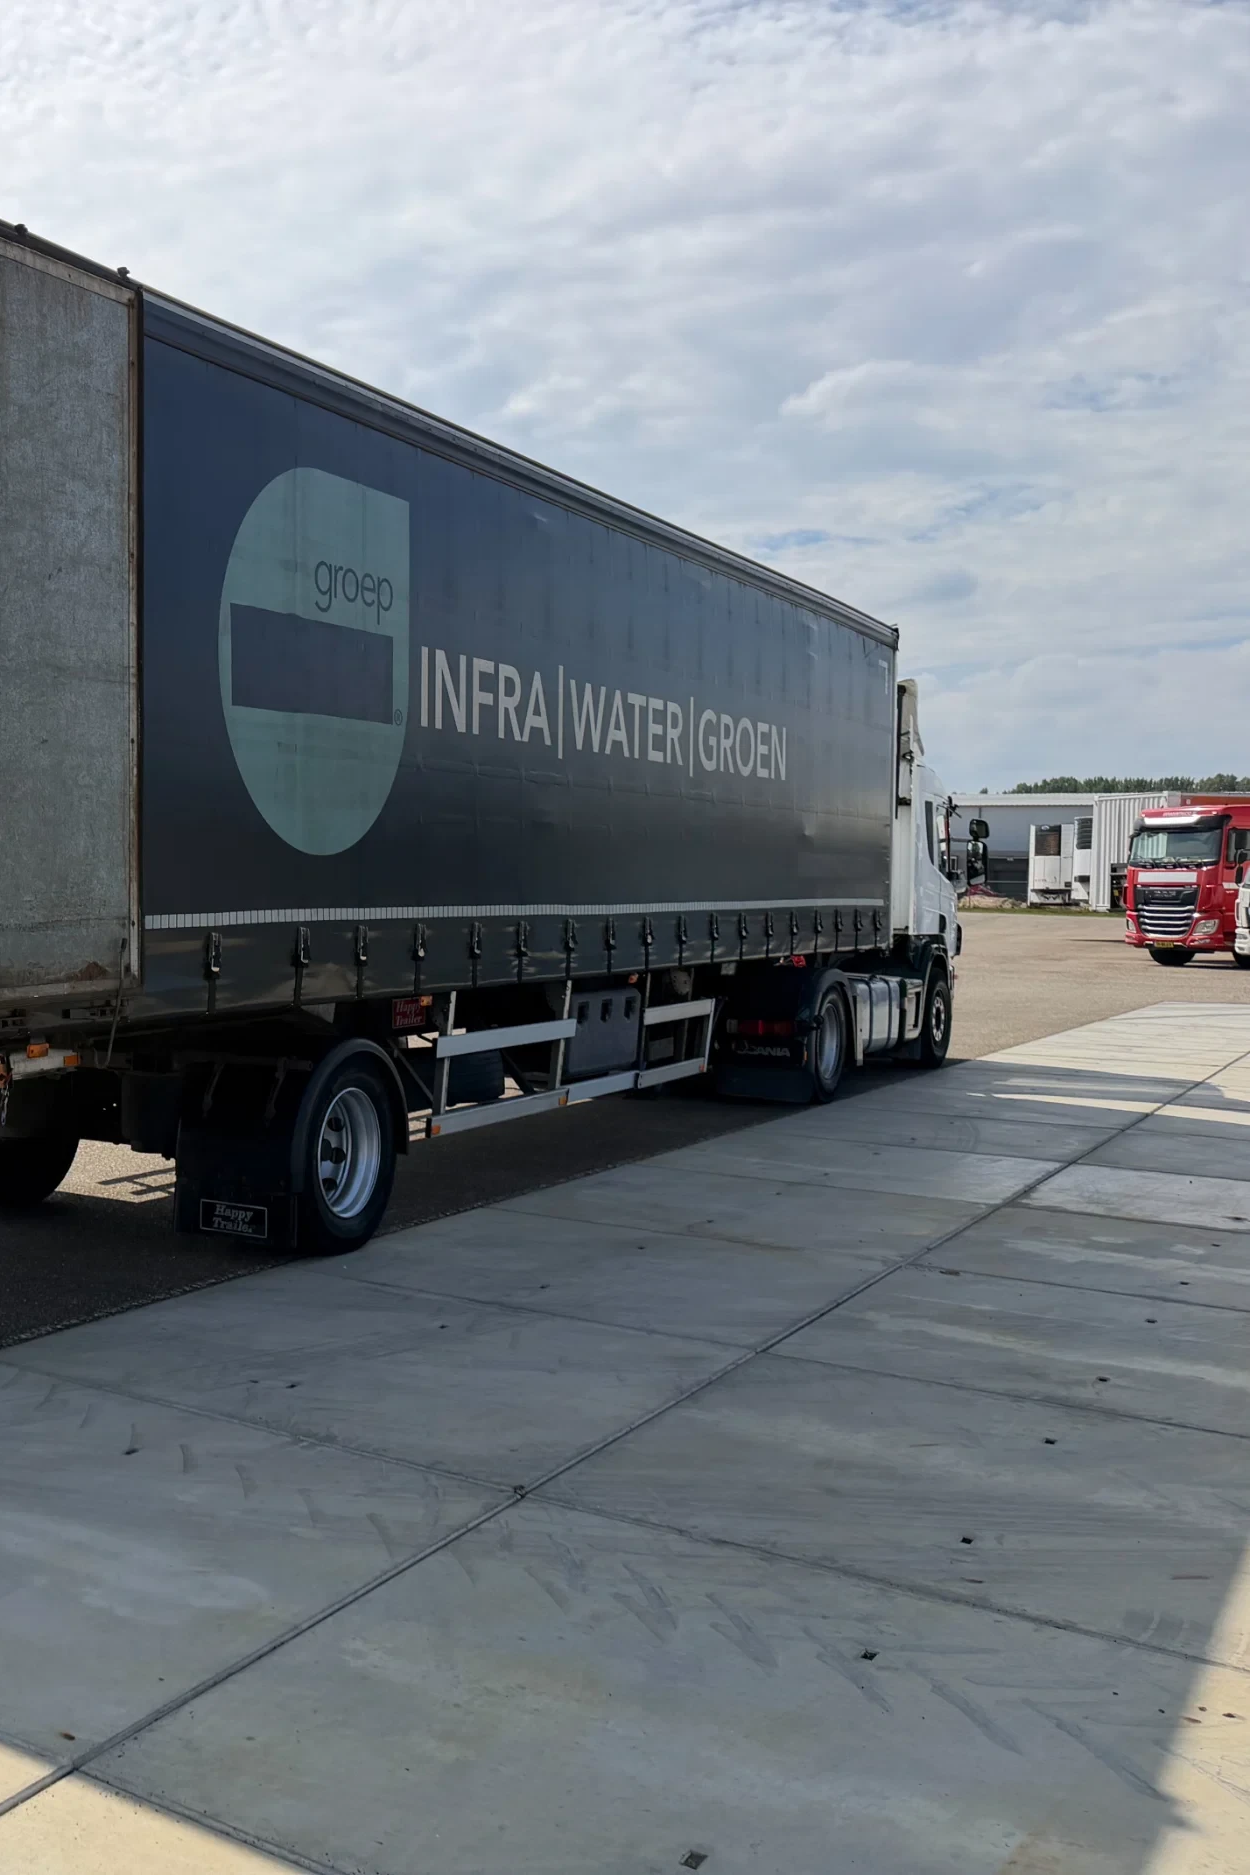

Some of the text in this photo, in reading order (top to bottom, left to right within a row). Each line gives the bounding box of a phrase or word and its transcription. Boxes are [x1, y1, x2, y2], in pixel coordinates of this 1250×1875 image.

[314, 559, 393, 624] groep
[396, 1014, 422, 1026] Trailer
[214, 1204, 254, 1222] Happy
